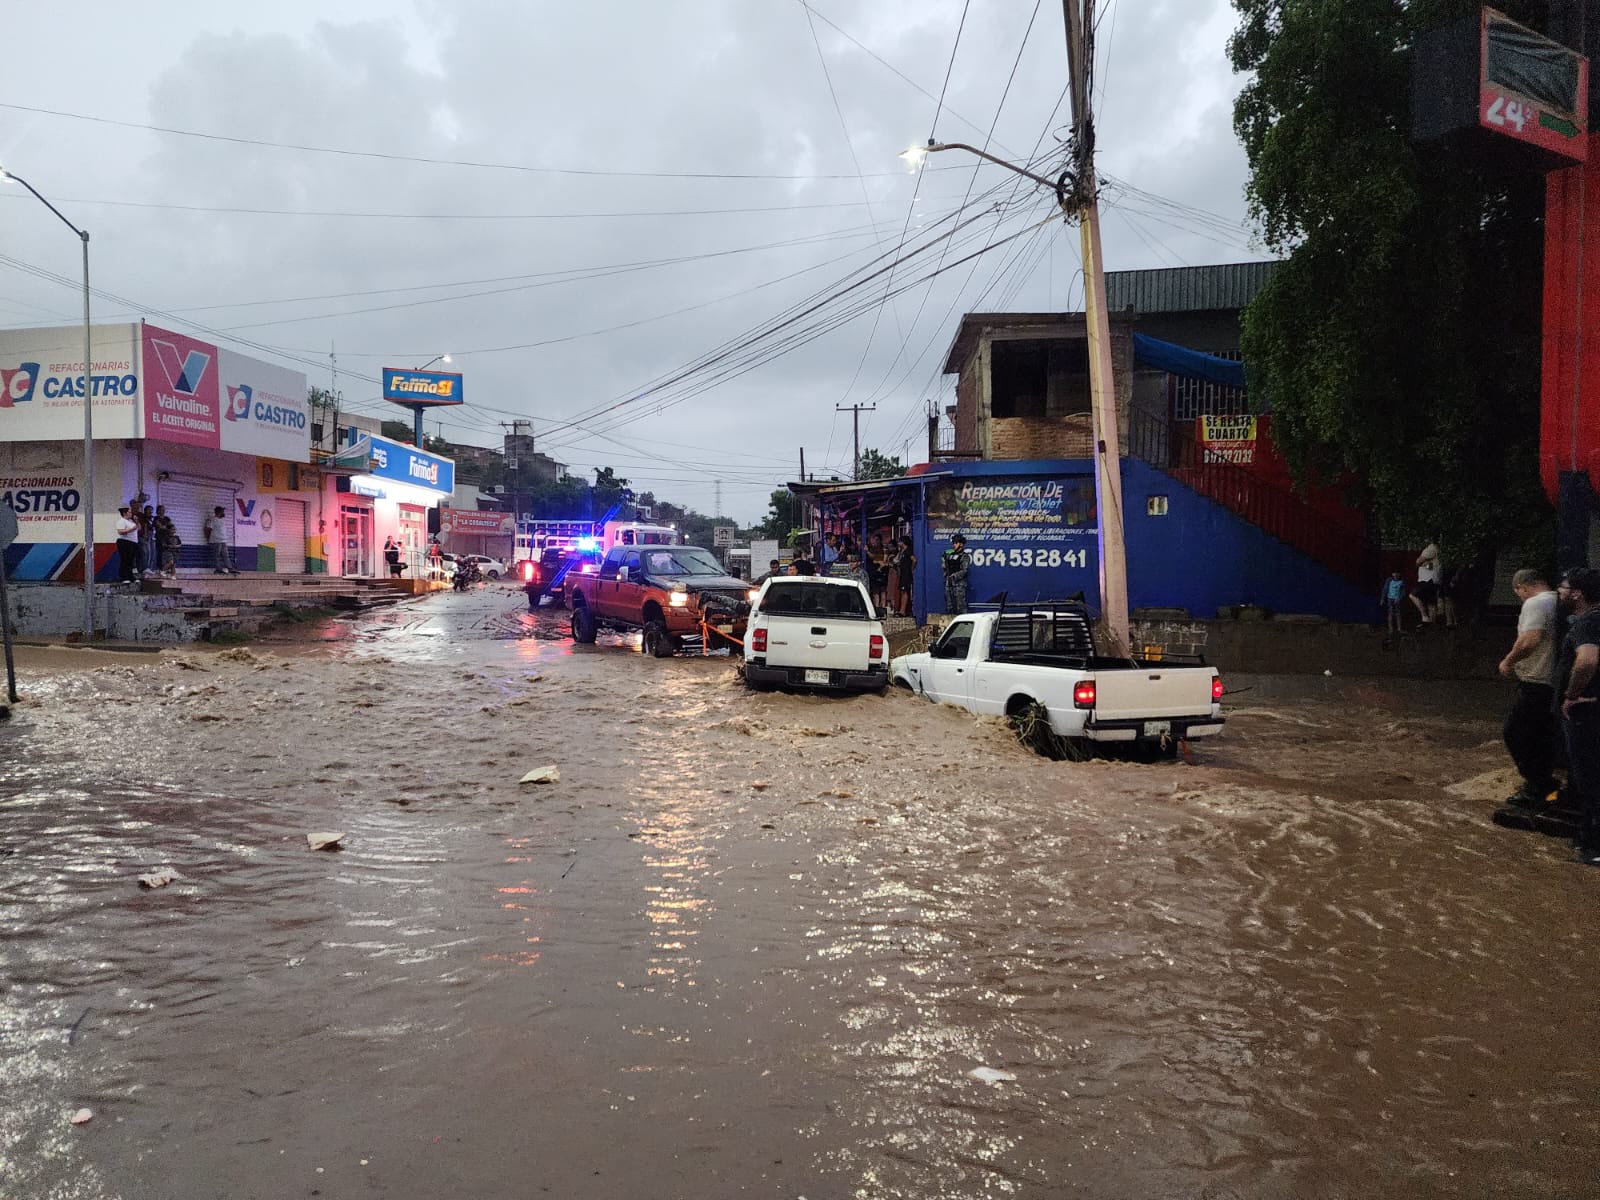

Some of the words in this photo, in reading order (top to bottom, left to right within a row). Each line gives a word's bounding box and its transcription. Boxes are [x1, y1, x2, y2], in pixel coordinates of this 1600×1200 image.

[49, 361, 129, 372] REFACCONARIAS
[43, 374, 138, 399] CASTRO
[156, 392, 210, 416] Valvoline
[152, 412, 160, 423] EL
[162, 414, 184, 427] ACEITE
[185, 418, 216, 432] ORIGINAL
[254, 402, 306, 429] CASTRO
[1208, 428, 1249, 439] CUARTO
[961, 482, 1041, 499] REPARACIÓN
